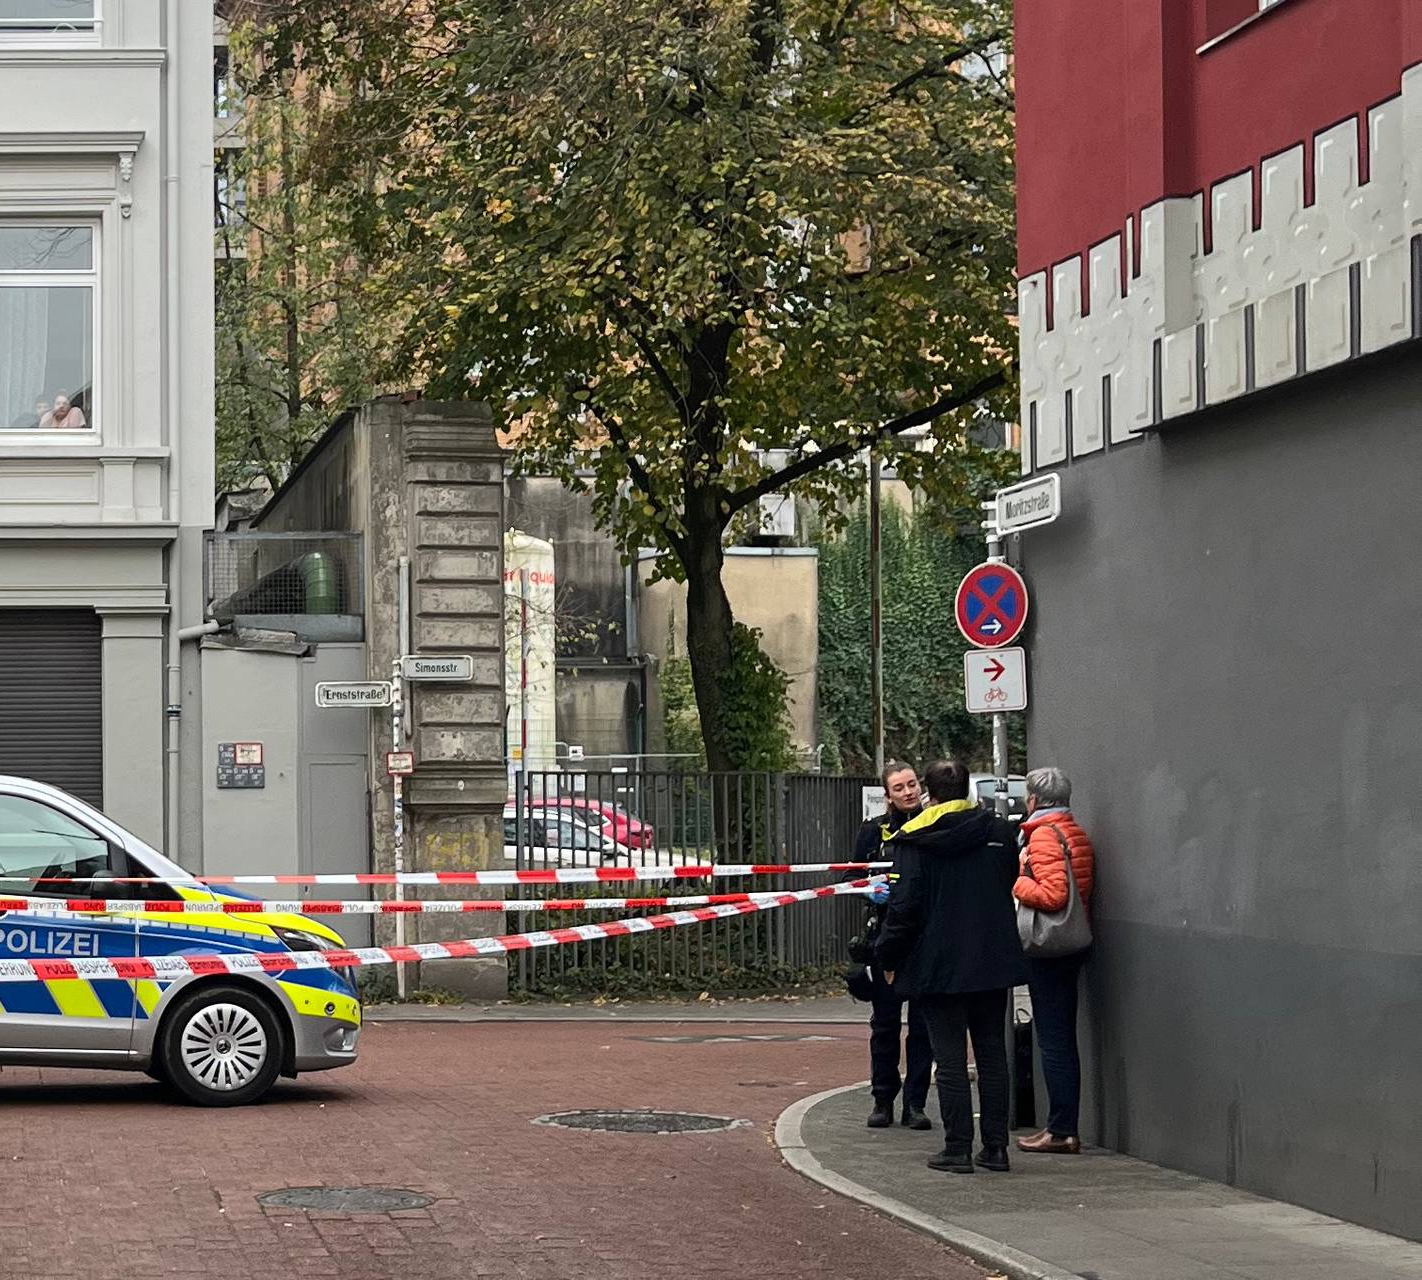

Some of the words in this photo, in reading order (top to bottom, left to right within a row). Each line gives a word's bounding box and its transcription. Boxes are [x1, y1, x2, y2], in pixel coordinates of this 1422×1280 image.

[326, 688, 383, 700] Ernststraße
[45, 961, 135, 975] POLIZEIABSPERRUNG
[141, 957, 226, 972] POLIZEIABSPERRUNG
